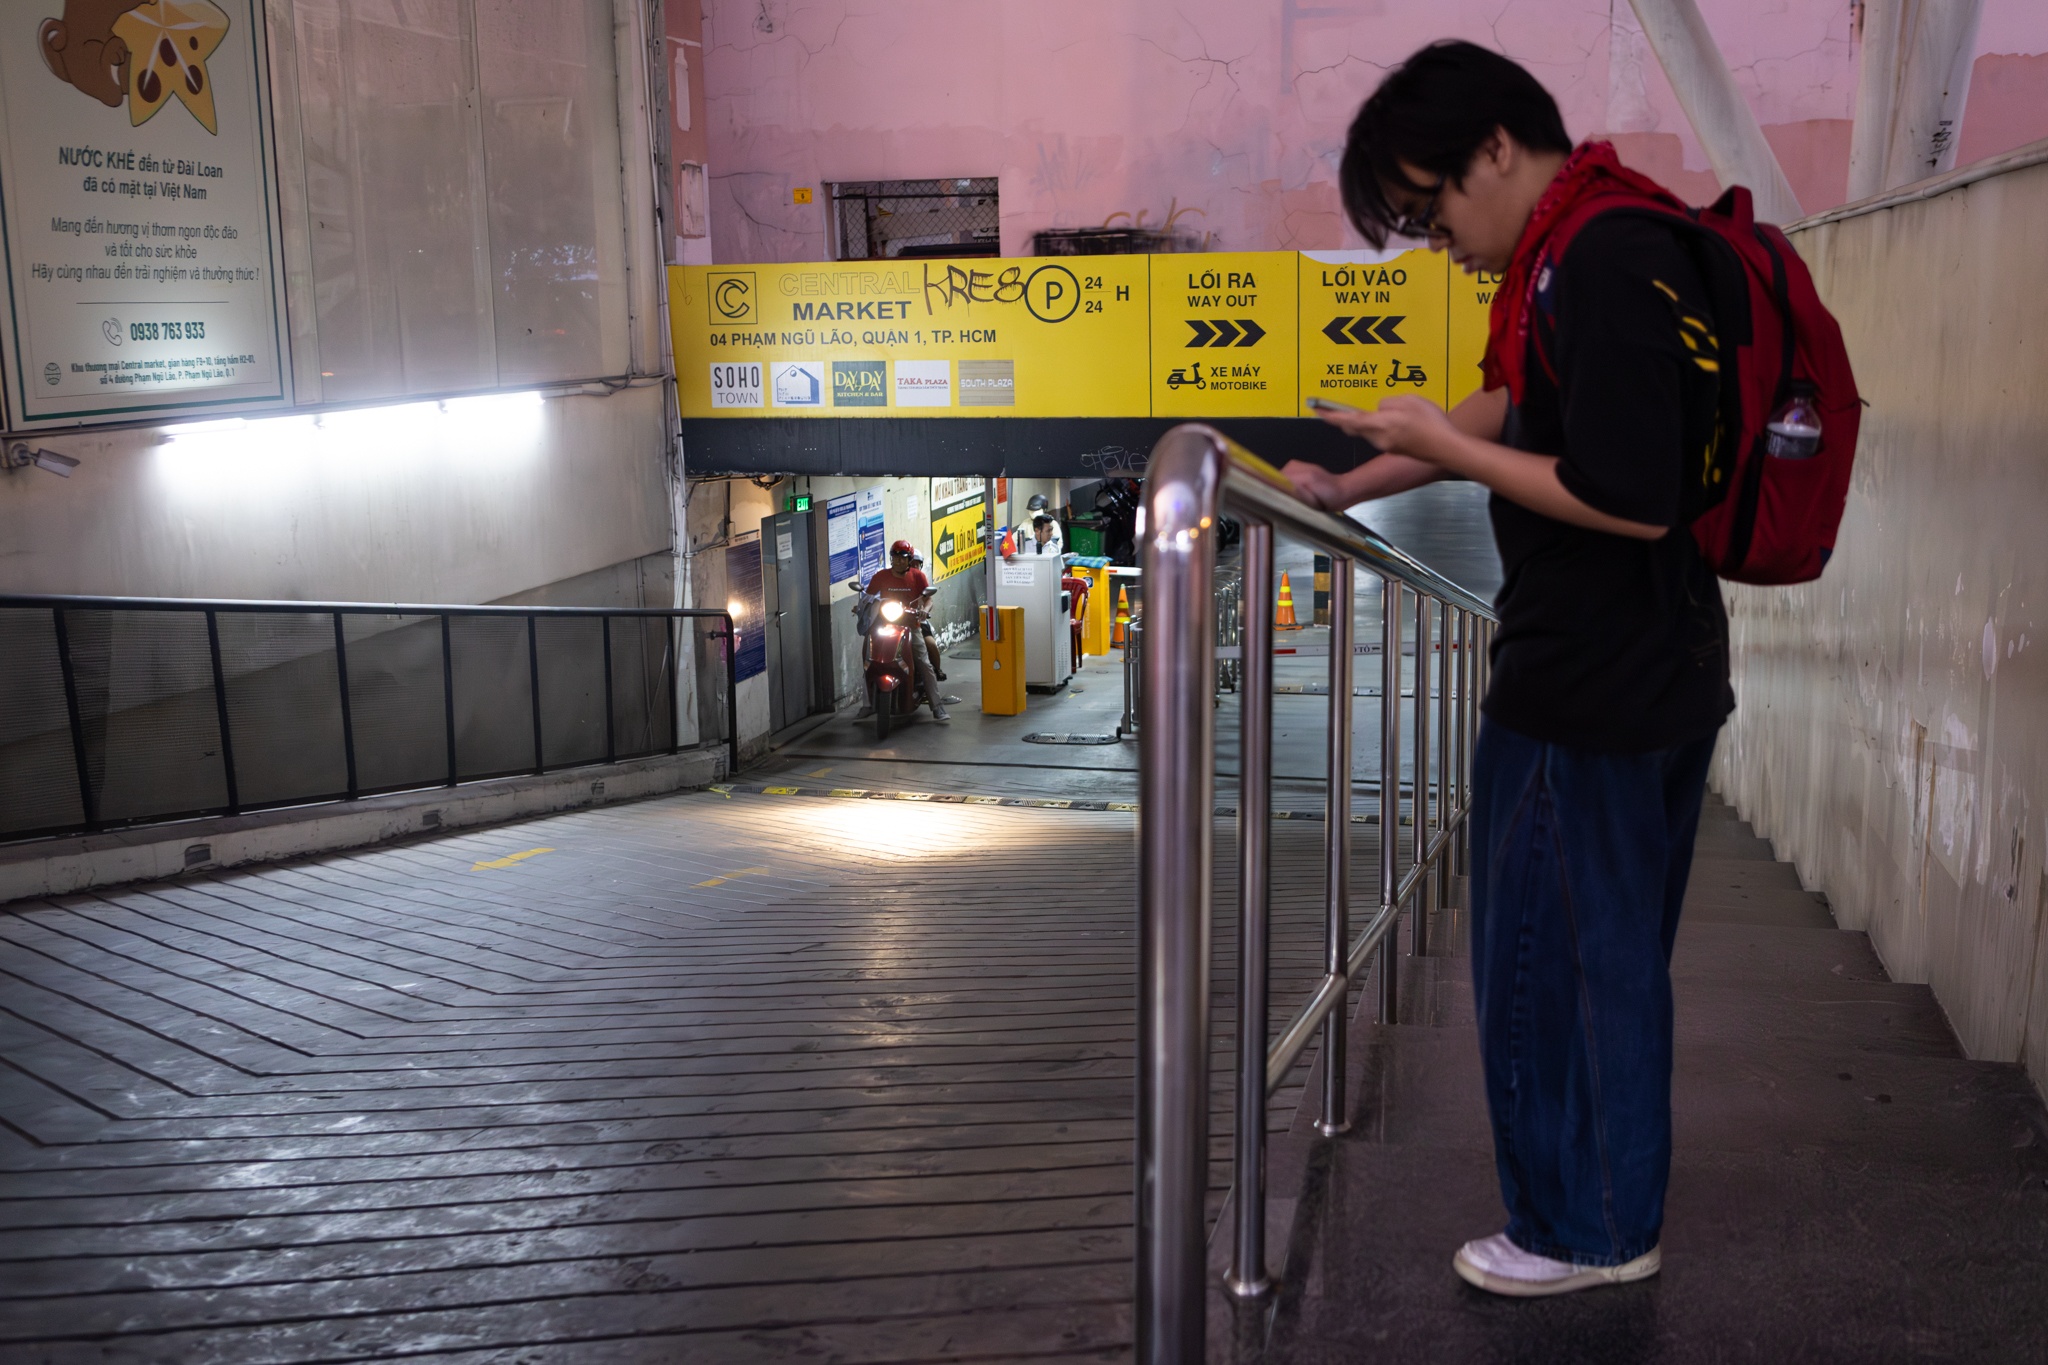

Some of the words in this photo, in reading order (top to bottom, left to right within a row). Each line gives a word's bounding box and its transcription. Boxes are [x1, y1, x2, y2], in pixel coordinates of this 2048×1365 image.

[59, 145, 102, 168] NƯỚC
[106, 149, 135, 171] KHẾ
[138, 154, 159, 172] đến
[162, 159, 175, 174] từ
[177, 160, 194, 176] Đài
[197, 162, 223, 178] Loan
[83, 176, 98, 192] đã
[102, 178, 116, 194] có
[119, 180, 141, 198] mặt
[143, 182, 157, 200] tại
[159, 182, 181, 201] Việt
[183, 184, 207, 200] Nam
[52, 217, 81, 236] Mang
[84, 216, 104, 234] đến
[106, 220, 138, 238] hương
[141, 222, 150, 238] vị
[152, 222, 176, 236] thơm
[178, 226, 201, 240] ngon
[204, 224, 220, 240] độc
[222, 225, 238, 240] đáo
[105, 242, 116, 256] và
[120, 240, 132, 257] tốt
[135, 243, 152, 258] cho
[155, 244, 172, 258] sức
[32, 263, 54, 282] Hãy
[56, 264, 82, 282] cùng
[86, 264, 110, 279] nhau
[114, 262, 132, 279] đến
[135, 264, 150, 280] trải
[153, 266, 186, 283] nghiệm
[190, 267, 200, 280] và
[202, 266, 233, 284] thưởng
[1188, 268, 1220, 289] LỐI
[1228, 272, 1256, 288] RA
[1322, 266, 1355, 286] LỐI
[1362, 266, 1407, 286] VÀO
[778, 271, 920, 296] CENTRAL
[1084, 276, 1103, 290] 24
[1116, 285, 1129, 301] H
[1187, 295, 1221, 307] WAY
[1226, 294, 1257, 307] OUT
[1335, 292, 1370, 304] WAY
[1375, 291, 1390, 303] IN
[792, 301, 912, 321] MARKET
[1085, 300, 1103, 313] 24
[130, 322, 159, 341] 0938
[161, 322, 182, 340] 763
[184, 322, 205, 339] 933
[710, 333, 727, 346] 04
[731, 332, 776, 349] PHẠM
[781, 329, 815, 346] NGŨ
[820, 328, 858, 348] LÃO,
[862, 328, 909, 348] QUẬN
[914, 330, 927, 346] 1,
[931, 330, 955, 344] TP.
[960, 329, 996, 344] HCM
[1210, 366, 1228, 377] XE
[1232, 364, 1261, 377] MÁY
[1326, 364, 1344, 374] XE
[1348, 361, 1378, 374] MÁY
[714, 366, 760, 388] SOHO
[834, 370, 858, 391] DAY
[860, 370, 884, 391] DAY
[960, 378, 986, 388] SOUTH
[987, 378, 1013, 388] PLAZA
[1210, 382, 1267, 390] MOTOBIKE
[1320, 379, 1378, 388] MOTOBIKE
[717, 392, 758, 404] TOWN
